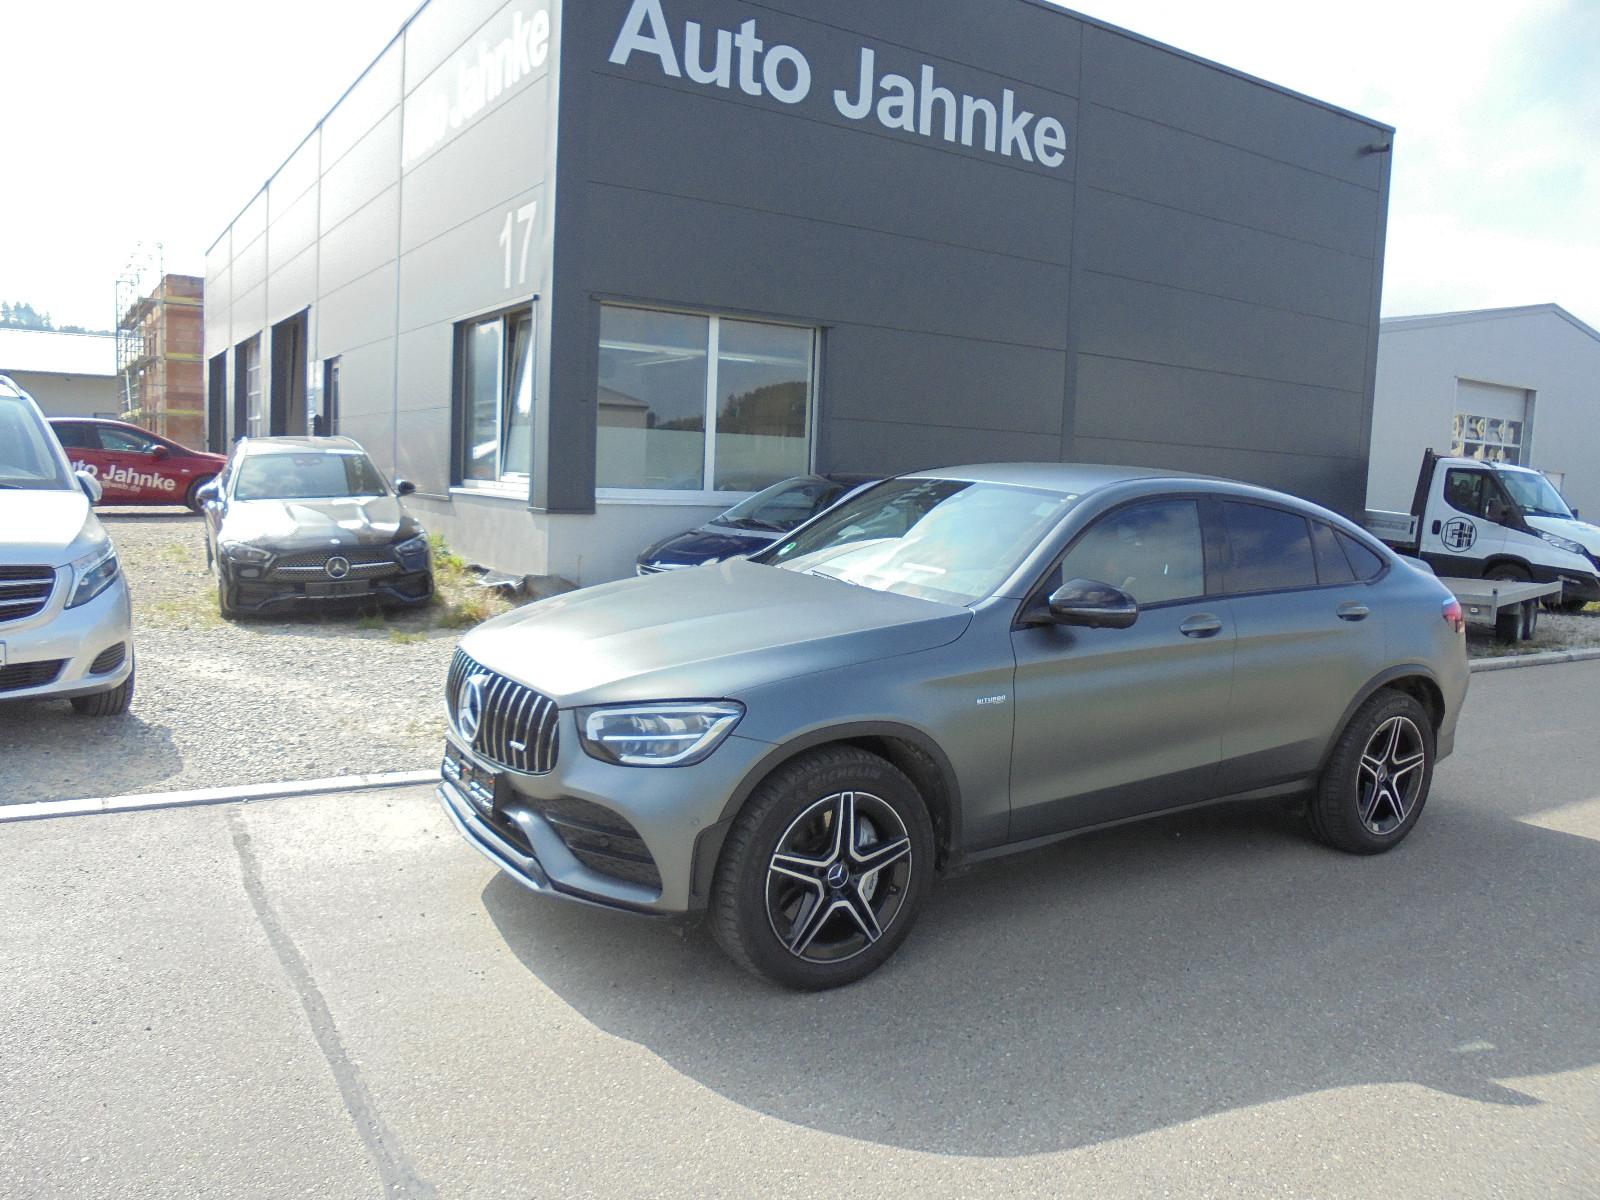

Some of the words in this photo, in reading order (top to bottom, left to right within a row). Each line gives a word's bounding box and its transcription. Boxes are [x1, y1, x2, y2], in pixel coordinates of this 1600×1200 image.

[608, 0, 811, 104] Auto
[833, 46, 1066, 167] Jahnke
[499, 201, 537, 289] 17
[102, 464, 176, 491] Jahnke
